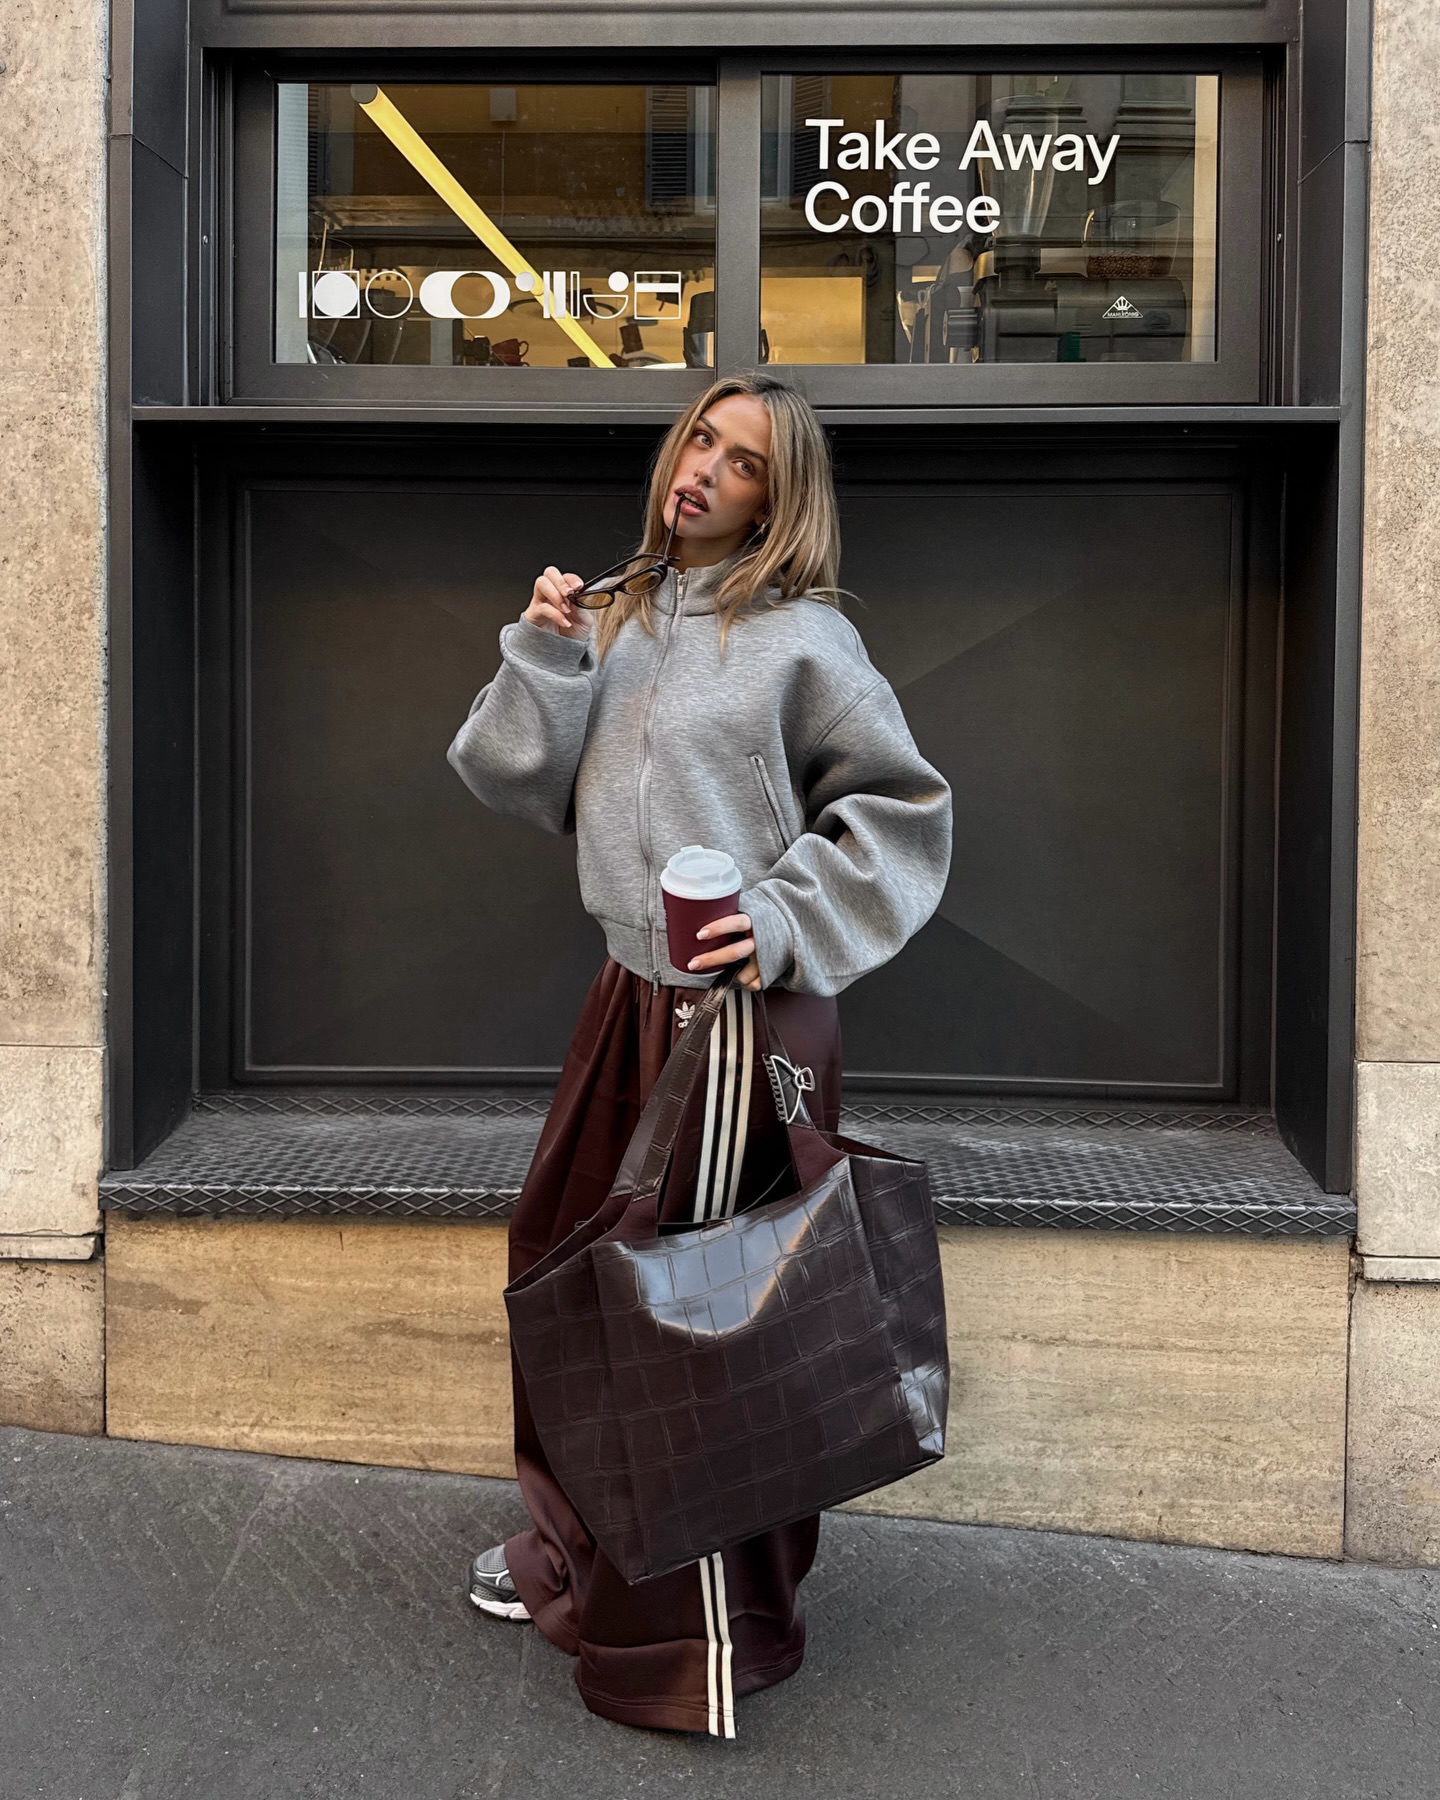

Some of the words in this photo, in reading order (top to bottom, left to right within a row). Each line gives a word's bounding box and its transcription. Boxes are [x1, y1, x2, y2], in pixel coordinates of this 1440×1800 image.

[806, 119, 940, 171] Take
[958, 119, 1120, 186] Away
[804, 181, 1001, 234] Coffee
